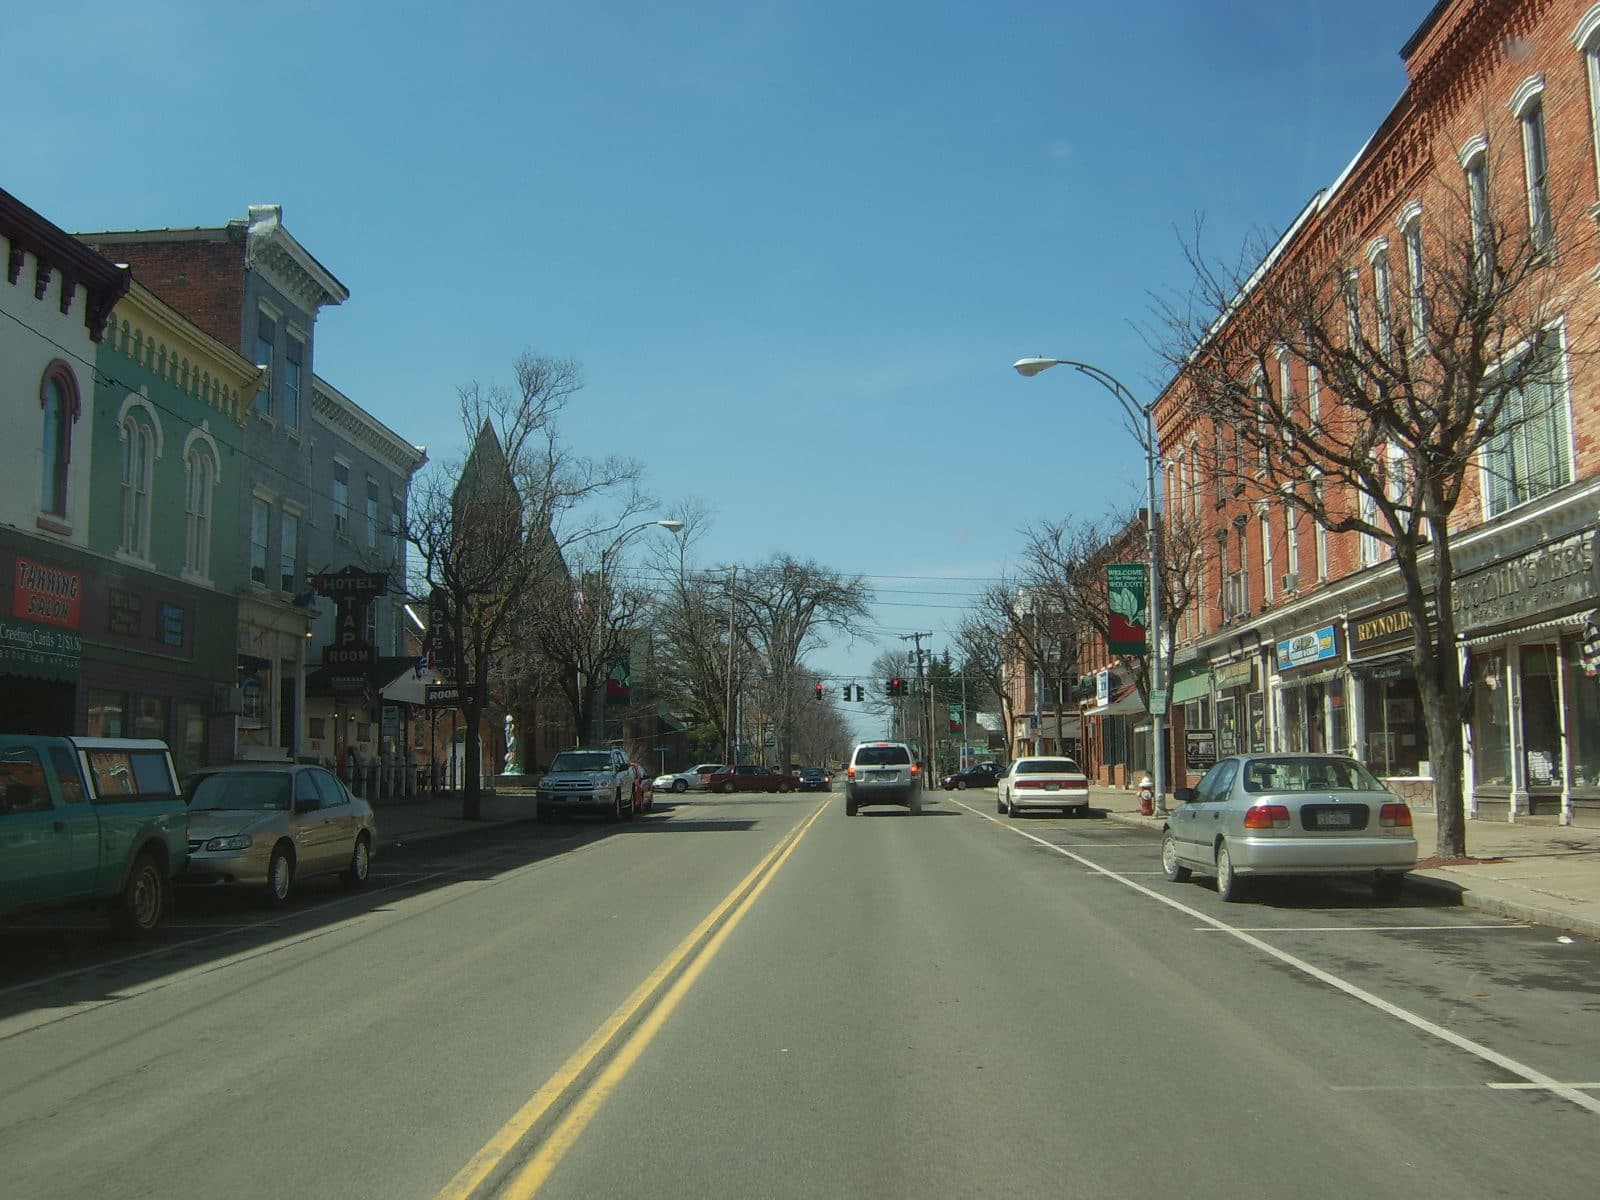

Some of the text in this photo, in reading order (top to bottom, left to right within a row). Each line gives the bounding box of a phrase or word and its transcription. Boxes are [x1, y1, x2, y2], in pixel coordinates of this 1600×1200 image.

[20, 561, 78, 600] TANNING
[323, 576, 376, 590] HOTEL
[27, 594, 70, 618] SALON
[329, 648, 369, 664] ROOM
[429, 689, 459, 700] ROOM
